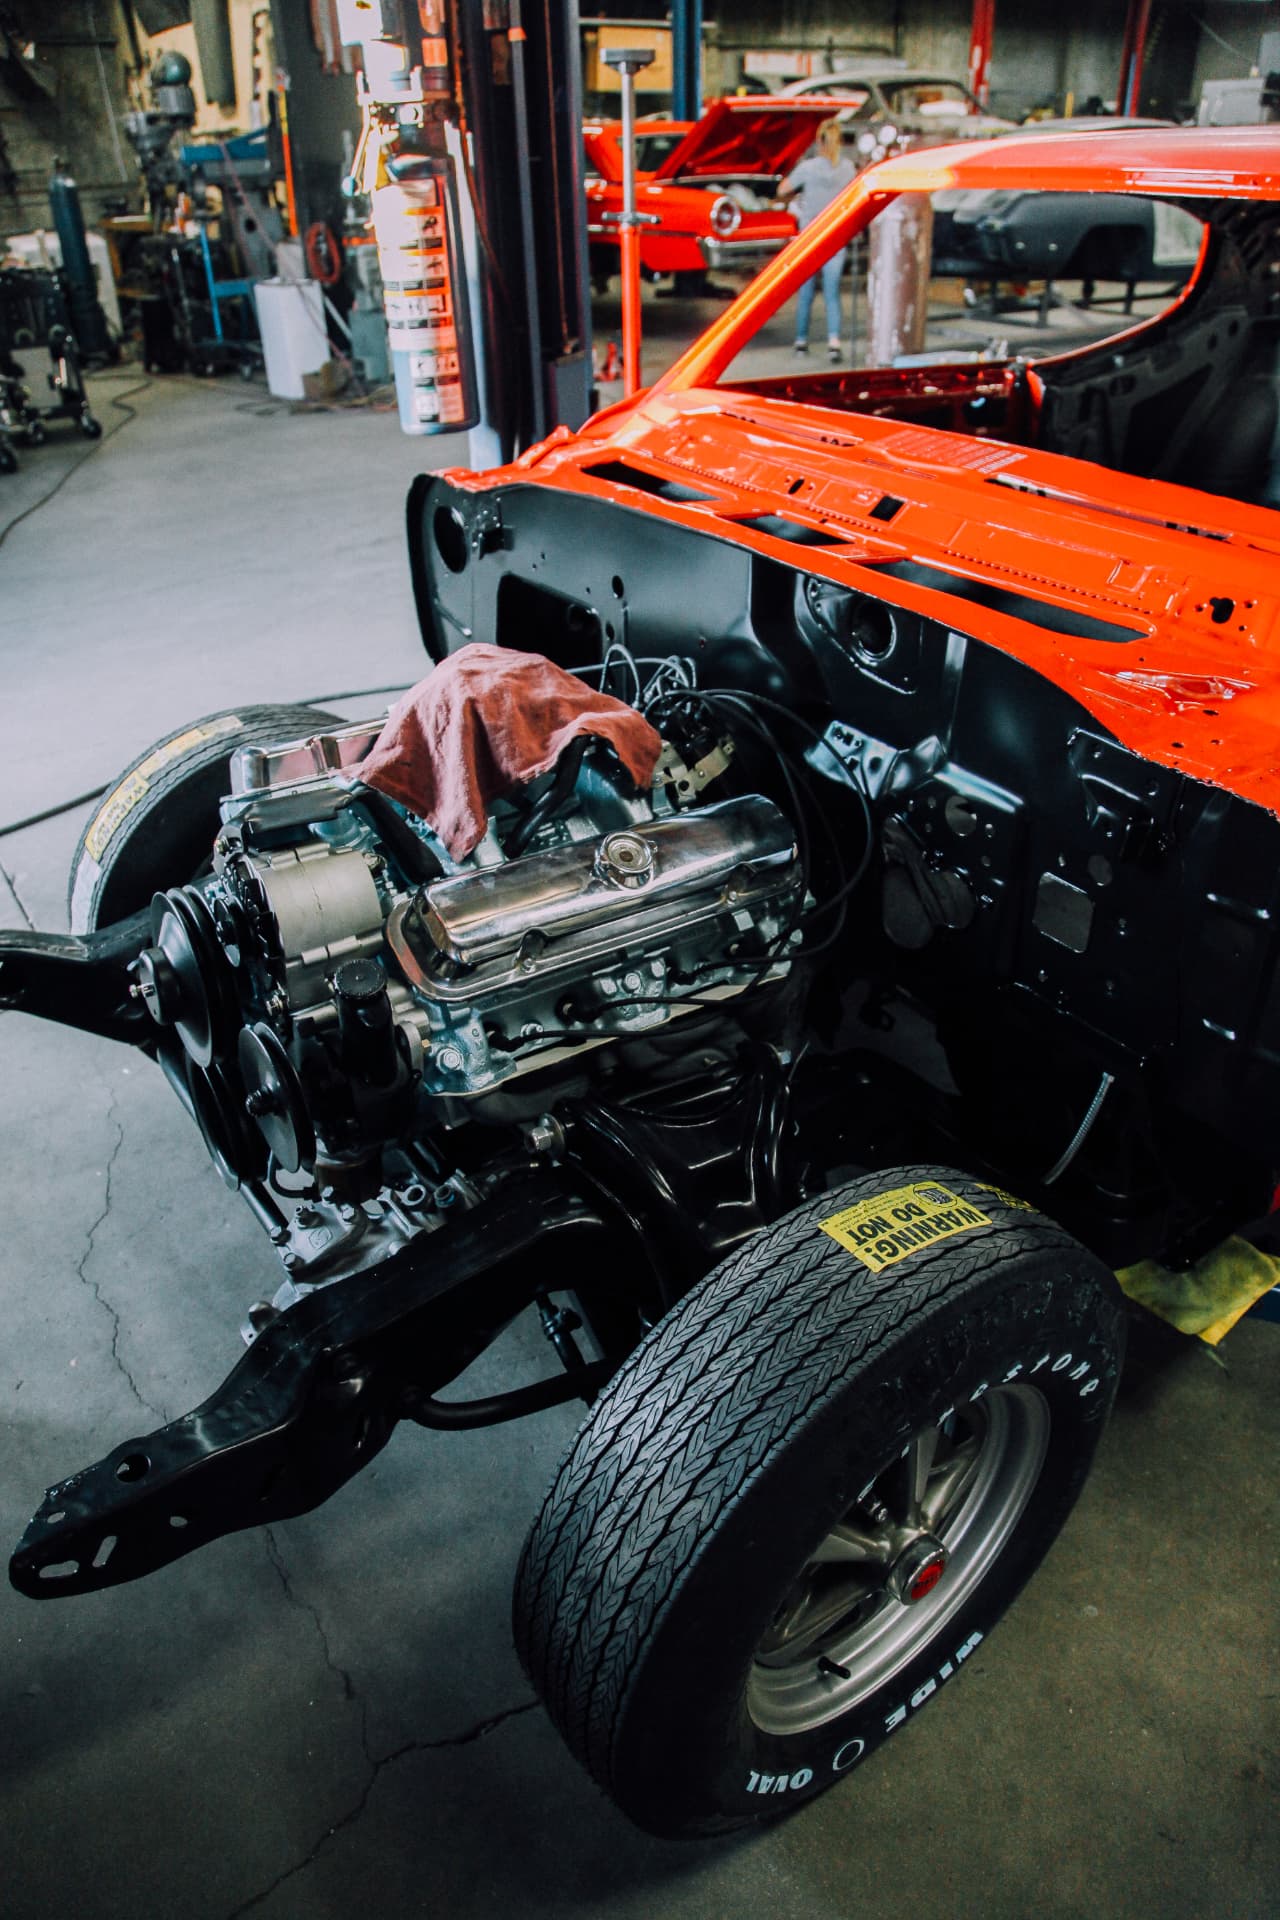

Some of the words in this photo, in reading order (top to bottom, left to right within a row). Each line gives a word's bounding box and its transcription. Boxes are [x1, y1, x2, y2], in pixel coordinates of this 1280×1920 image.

[891, 1202, 927, 1222] DO
[846, 1215, 895, 1246] NOT
[864, 1207, 985, 1264] WARNING!
[884, 1631, 984, 1733] WIDE
[745, 1767, 814, 1795] OVAL
